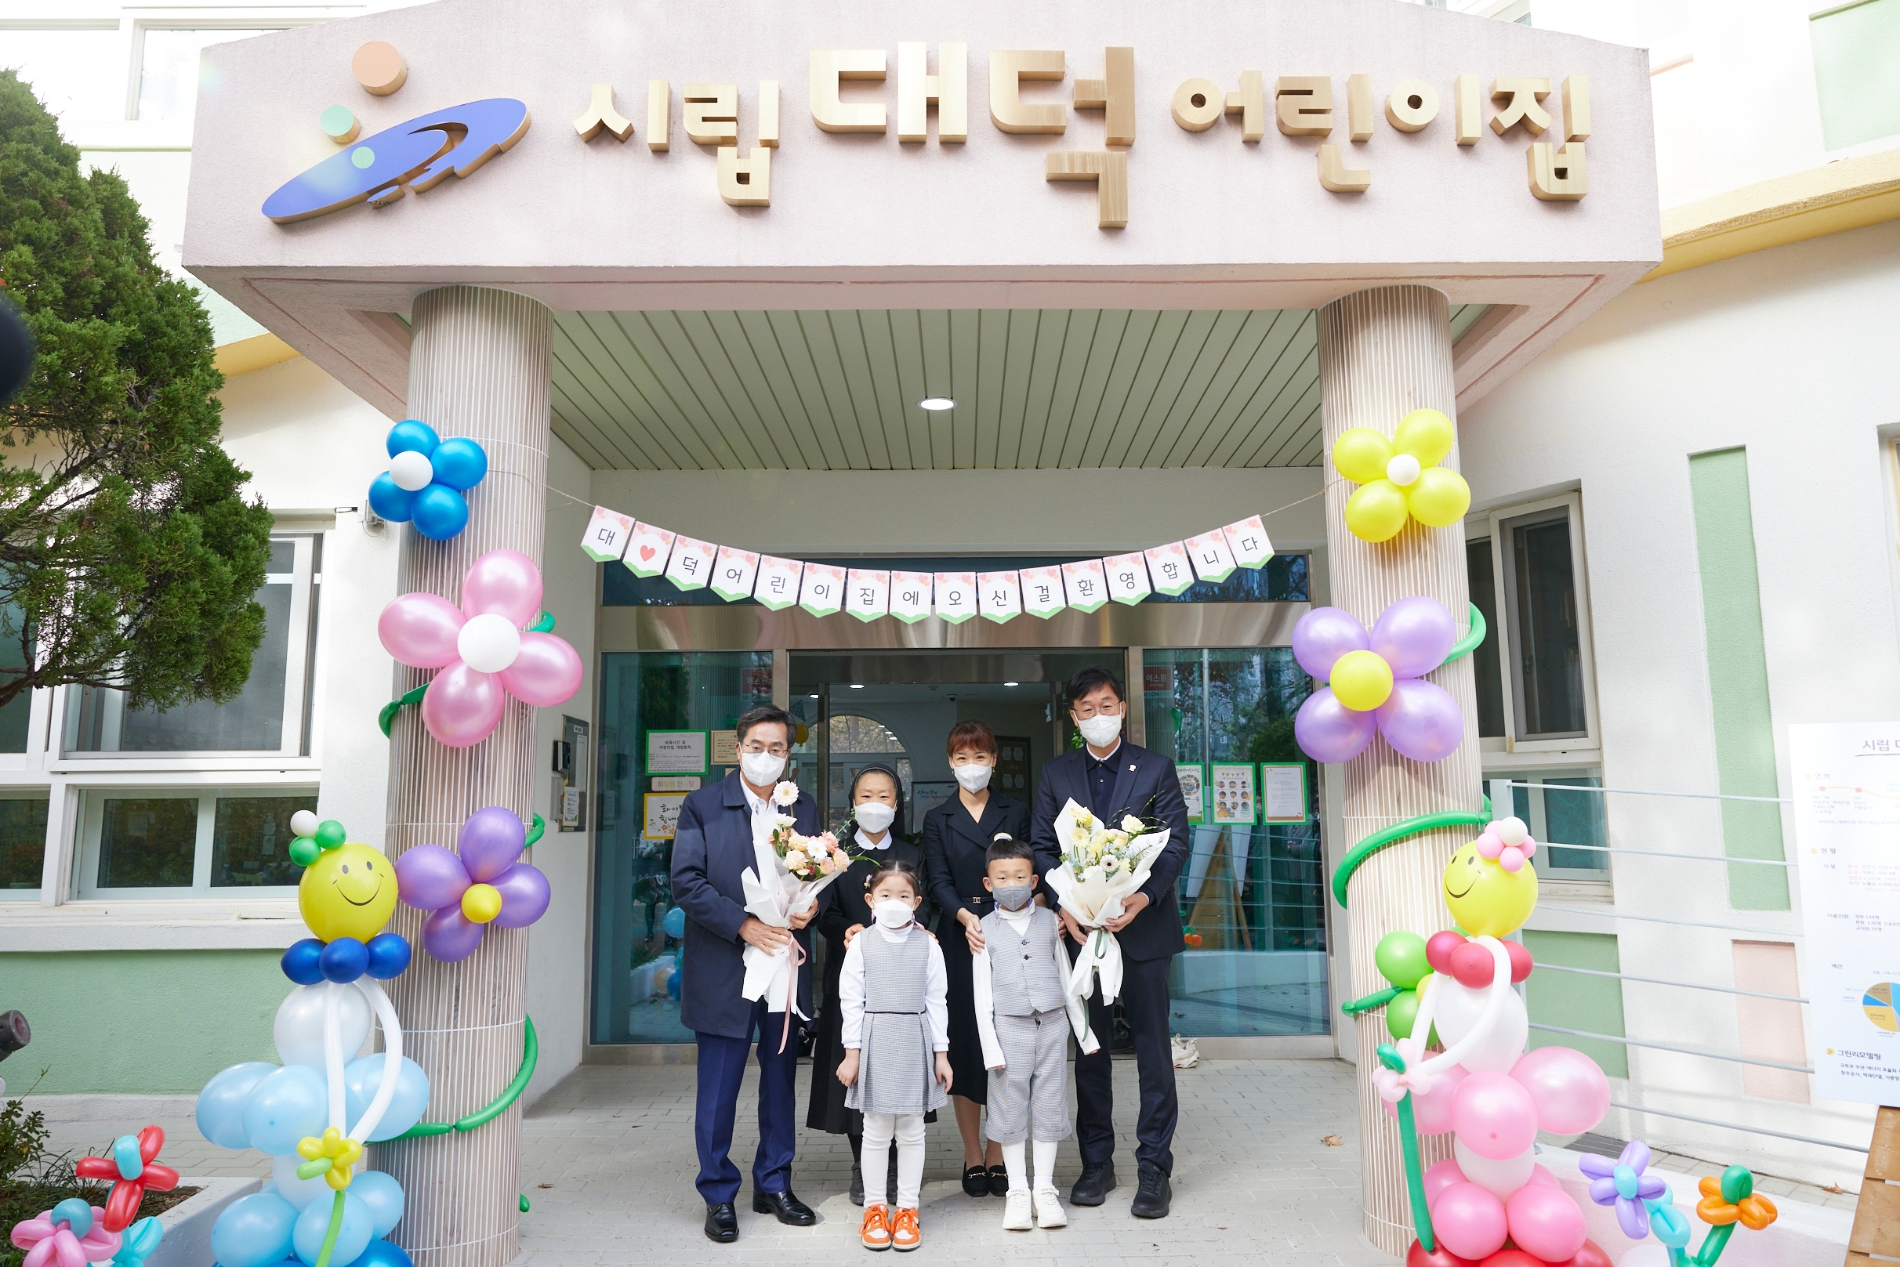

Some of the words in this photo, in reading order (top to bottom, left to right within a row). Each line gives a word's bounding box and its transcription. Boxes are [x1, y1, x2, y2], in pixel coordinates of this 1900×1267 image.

[571, 79, 780, 207] 시립
[809, 41, 1135, 228] 대덕
[1171, 70, 1591, 201] 어린이집
[1862, 739, 1889, 751] 시립
[1837, 1049, 1882, 1061] 그린리모델링
